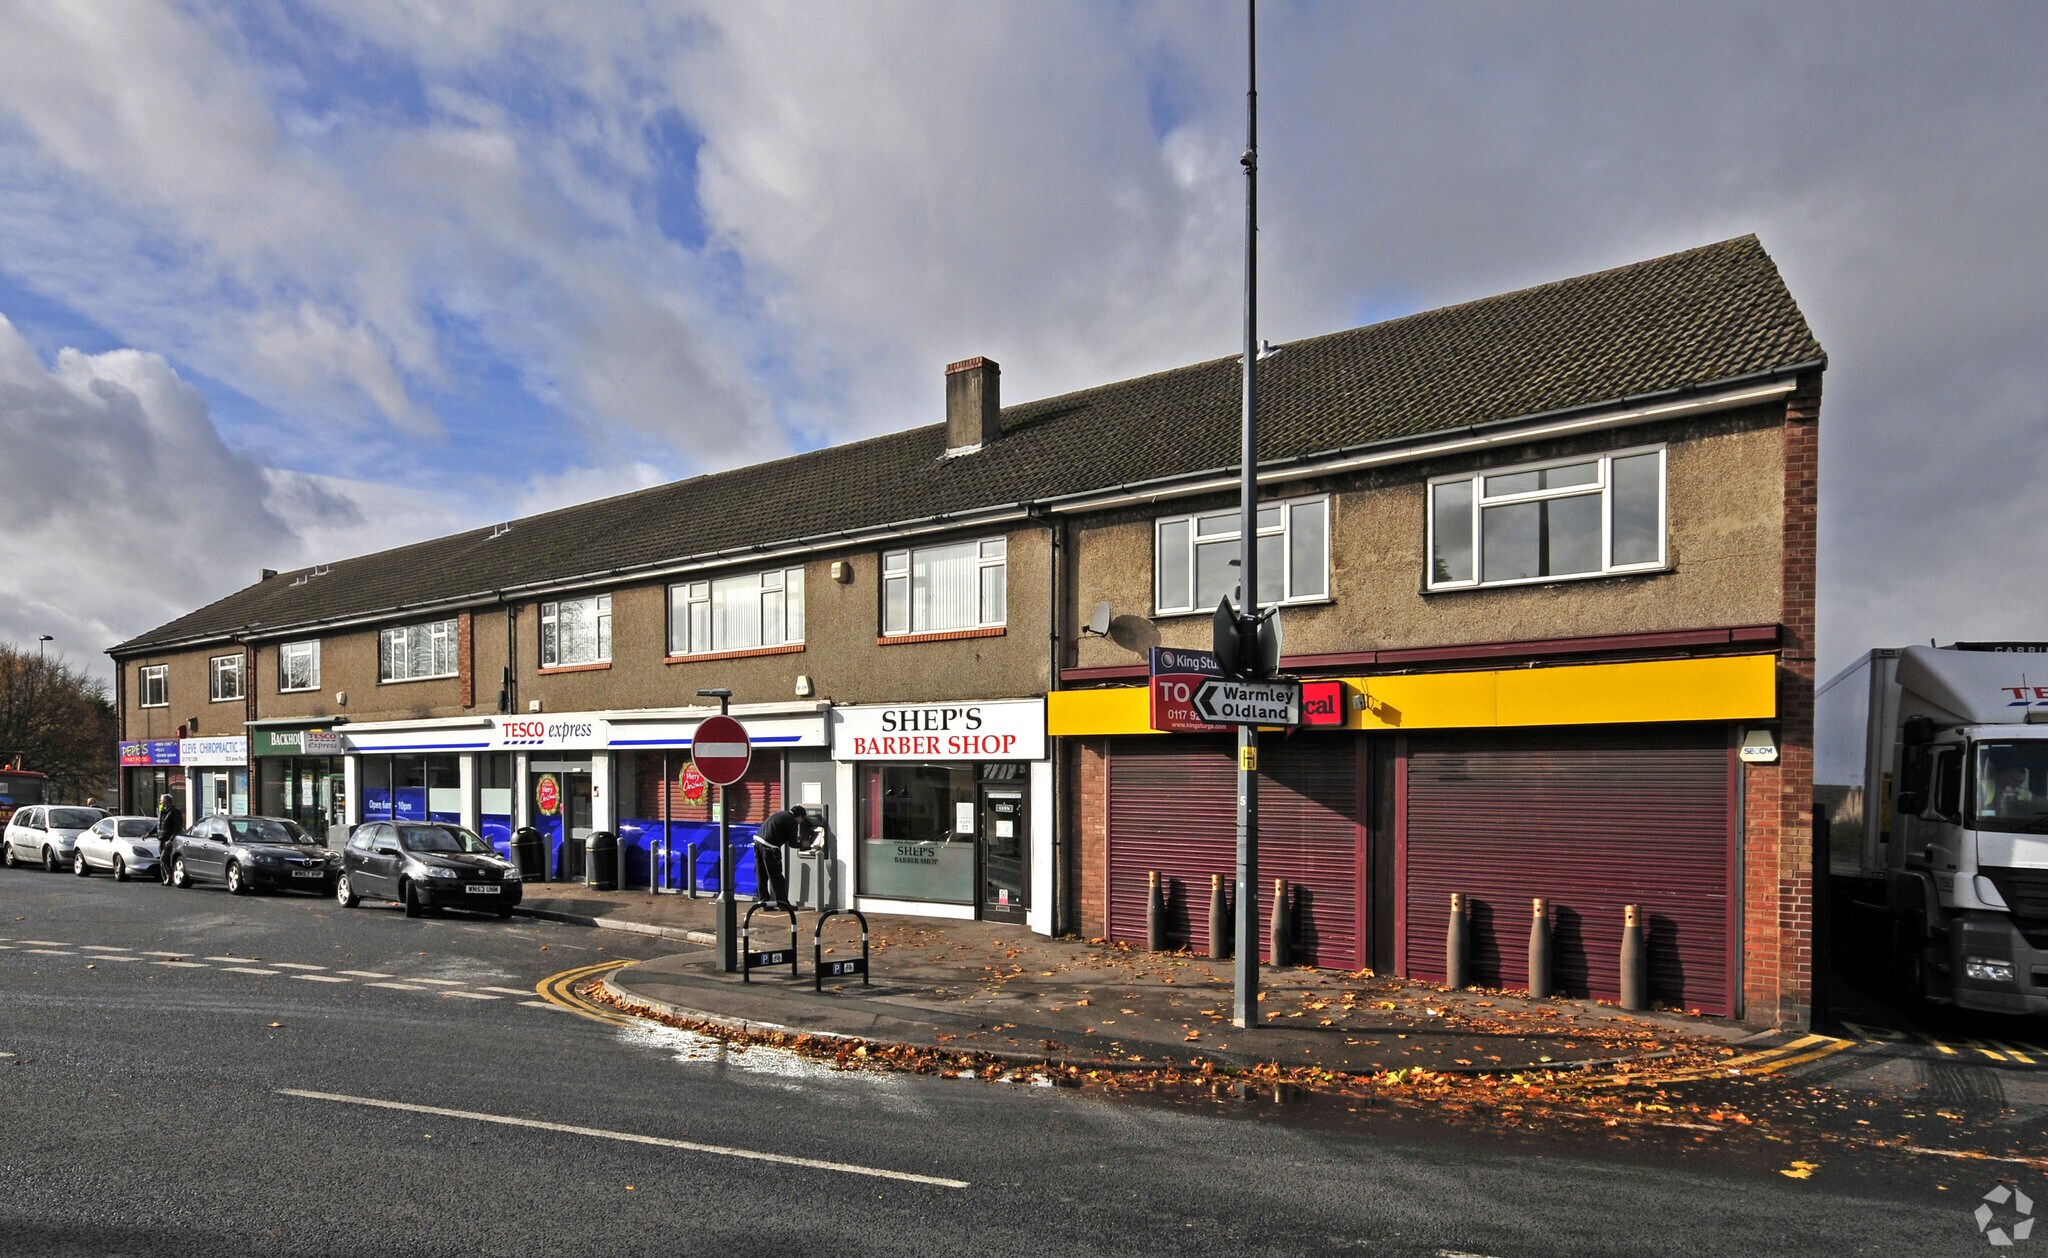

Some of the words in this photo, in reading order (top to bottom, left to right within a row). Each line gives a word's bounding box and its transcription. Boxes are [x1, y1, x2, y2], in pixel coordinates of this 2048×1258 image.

[1176, 654, 1200, 671] King
[1200, 656, 1220, 669] Stu
[1160, 682, 1190, 703] TO
[1223, 686, 1294, 704] Warmley
[1221, 703, 1289, 719] Oldland
[1302, 695, 1336, 715] cal
[882, 707, 982, 732] SHEP'S
[1167, 709, 1187, 720] 0117
[502, 721, 545, 737] TESCO
[548, 722, 592, 743] express
[182, 743, 197, 754] CLEVE
[199, 741, 238, 754] CHIROPRACTIC
[308, 741, 338, 750] express
[853, 737, 941, 755] BARBER
[948, 735, 1017, 755] SHOP
[1744, 747, 1773, 755] SECOM
[368, 800, 381, 810] Open
[398, 801, 412, 812] 10pm
[1240, 796, 1246, 806] 5
[897, 846, 935, 857] SHEP'S
